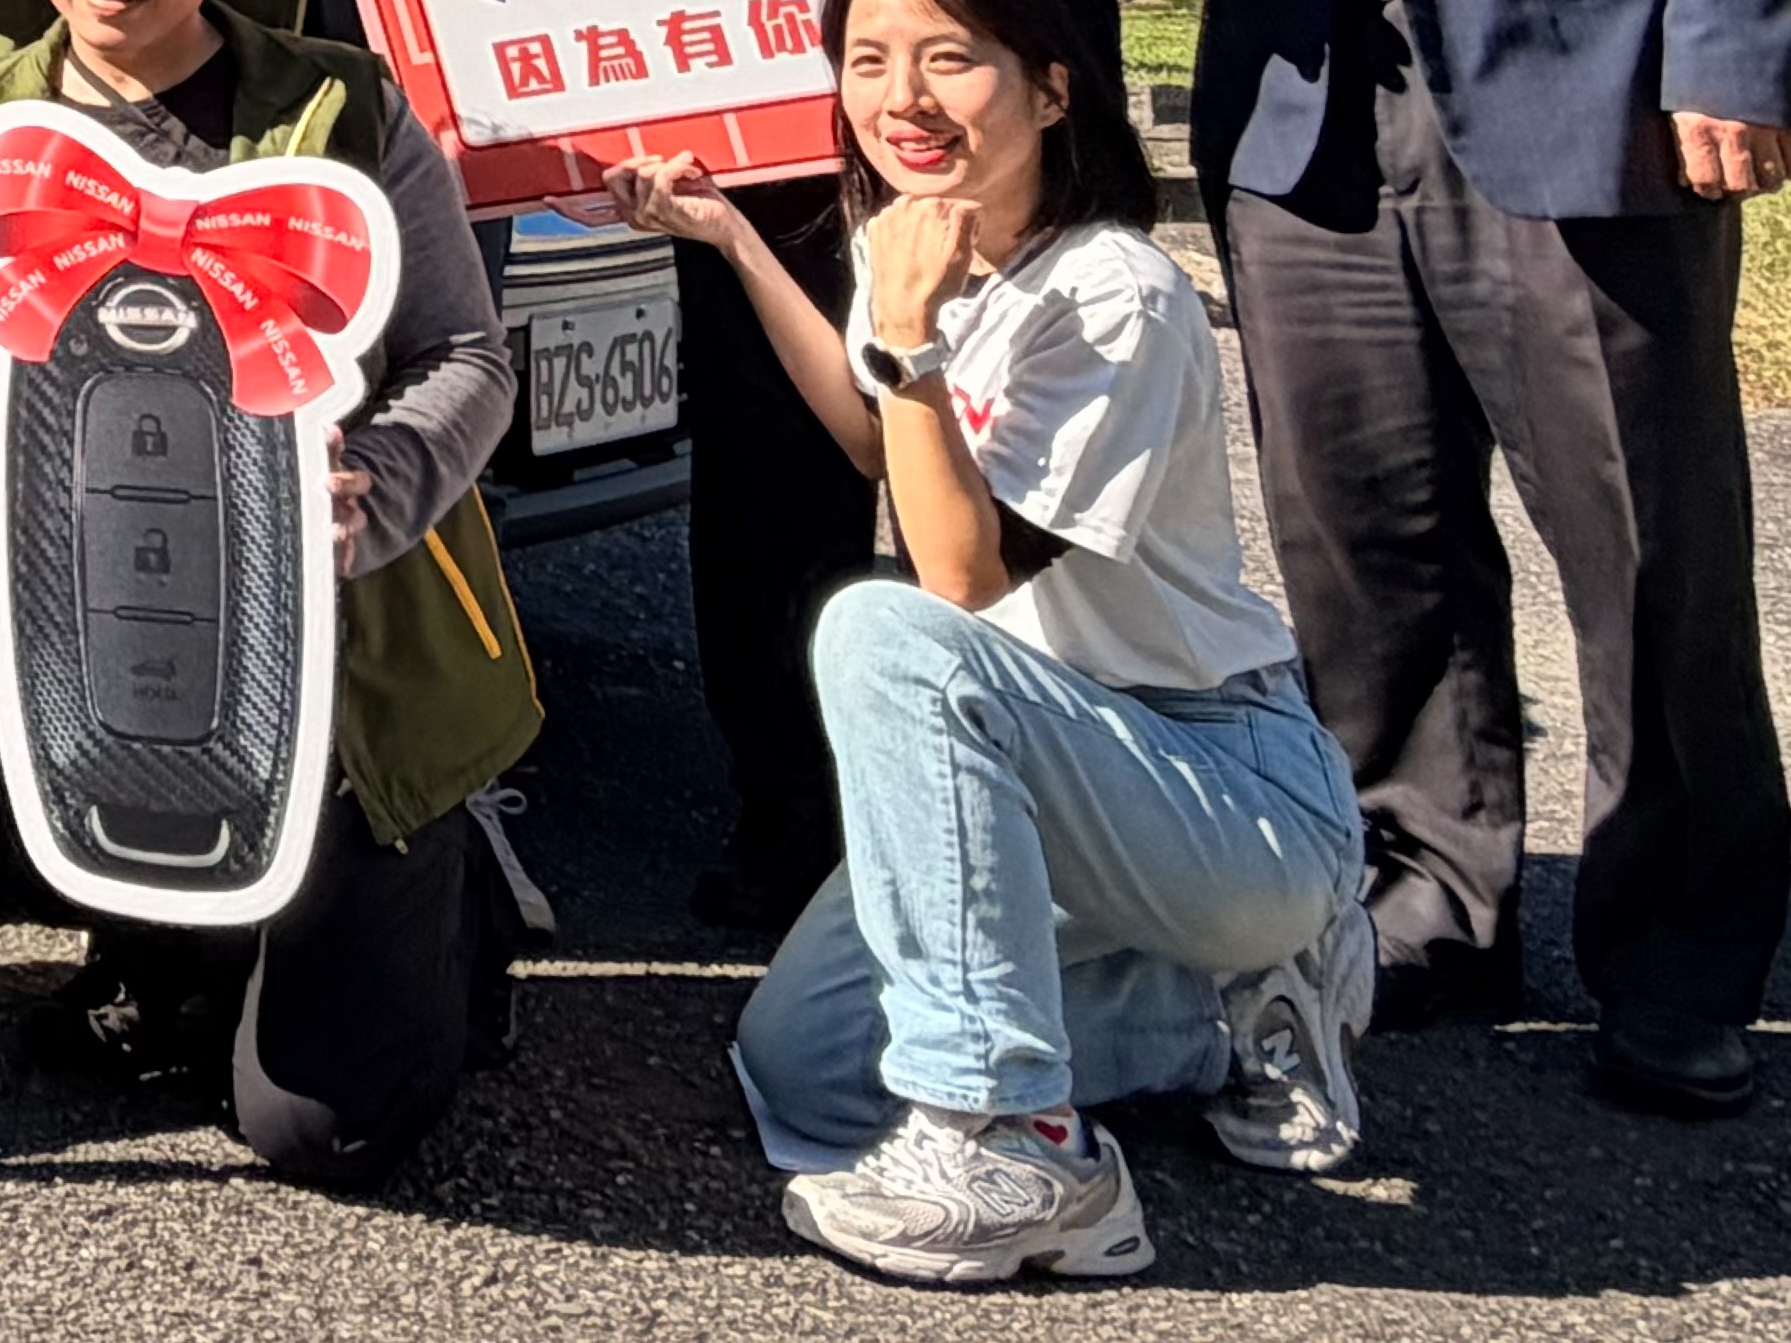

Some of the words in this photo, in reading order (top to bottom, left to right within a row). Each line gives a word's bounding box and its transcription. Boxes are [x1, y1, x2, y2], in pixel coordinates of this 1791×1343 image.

[65, 170, 136, 215] NISSAN
[53, 232, 125, 272] NISSAN
[196, 212, 271, 231] NISSAN
[288, 215, 364, 252] NISSAN
[190, 247, 258, 312] NISSAN
[260, 317, 309, 396] NISSAN
